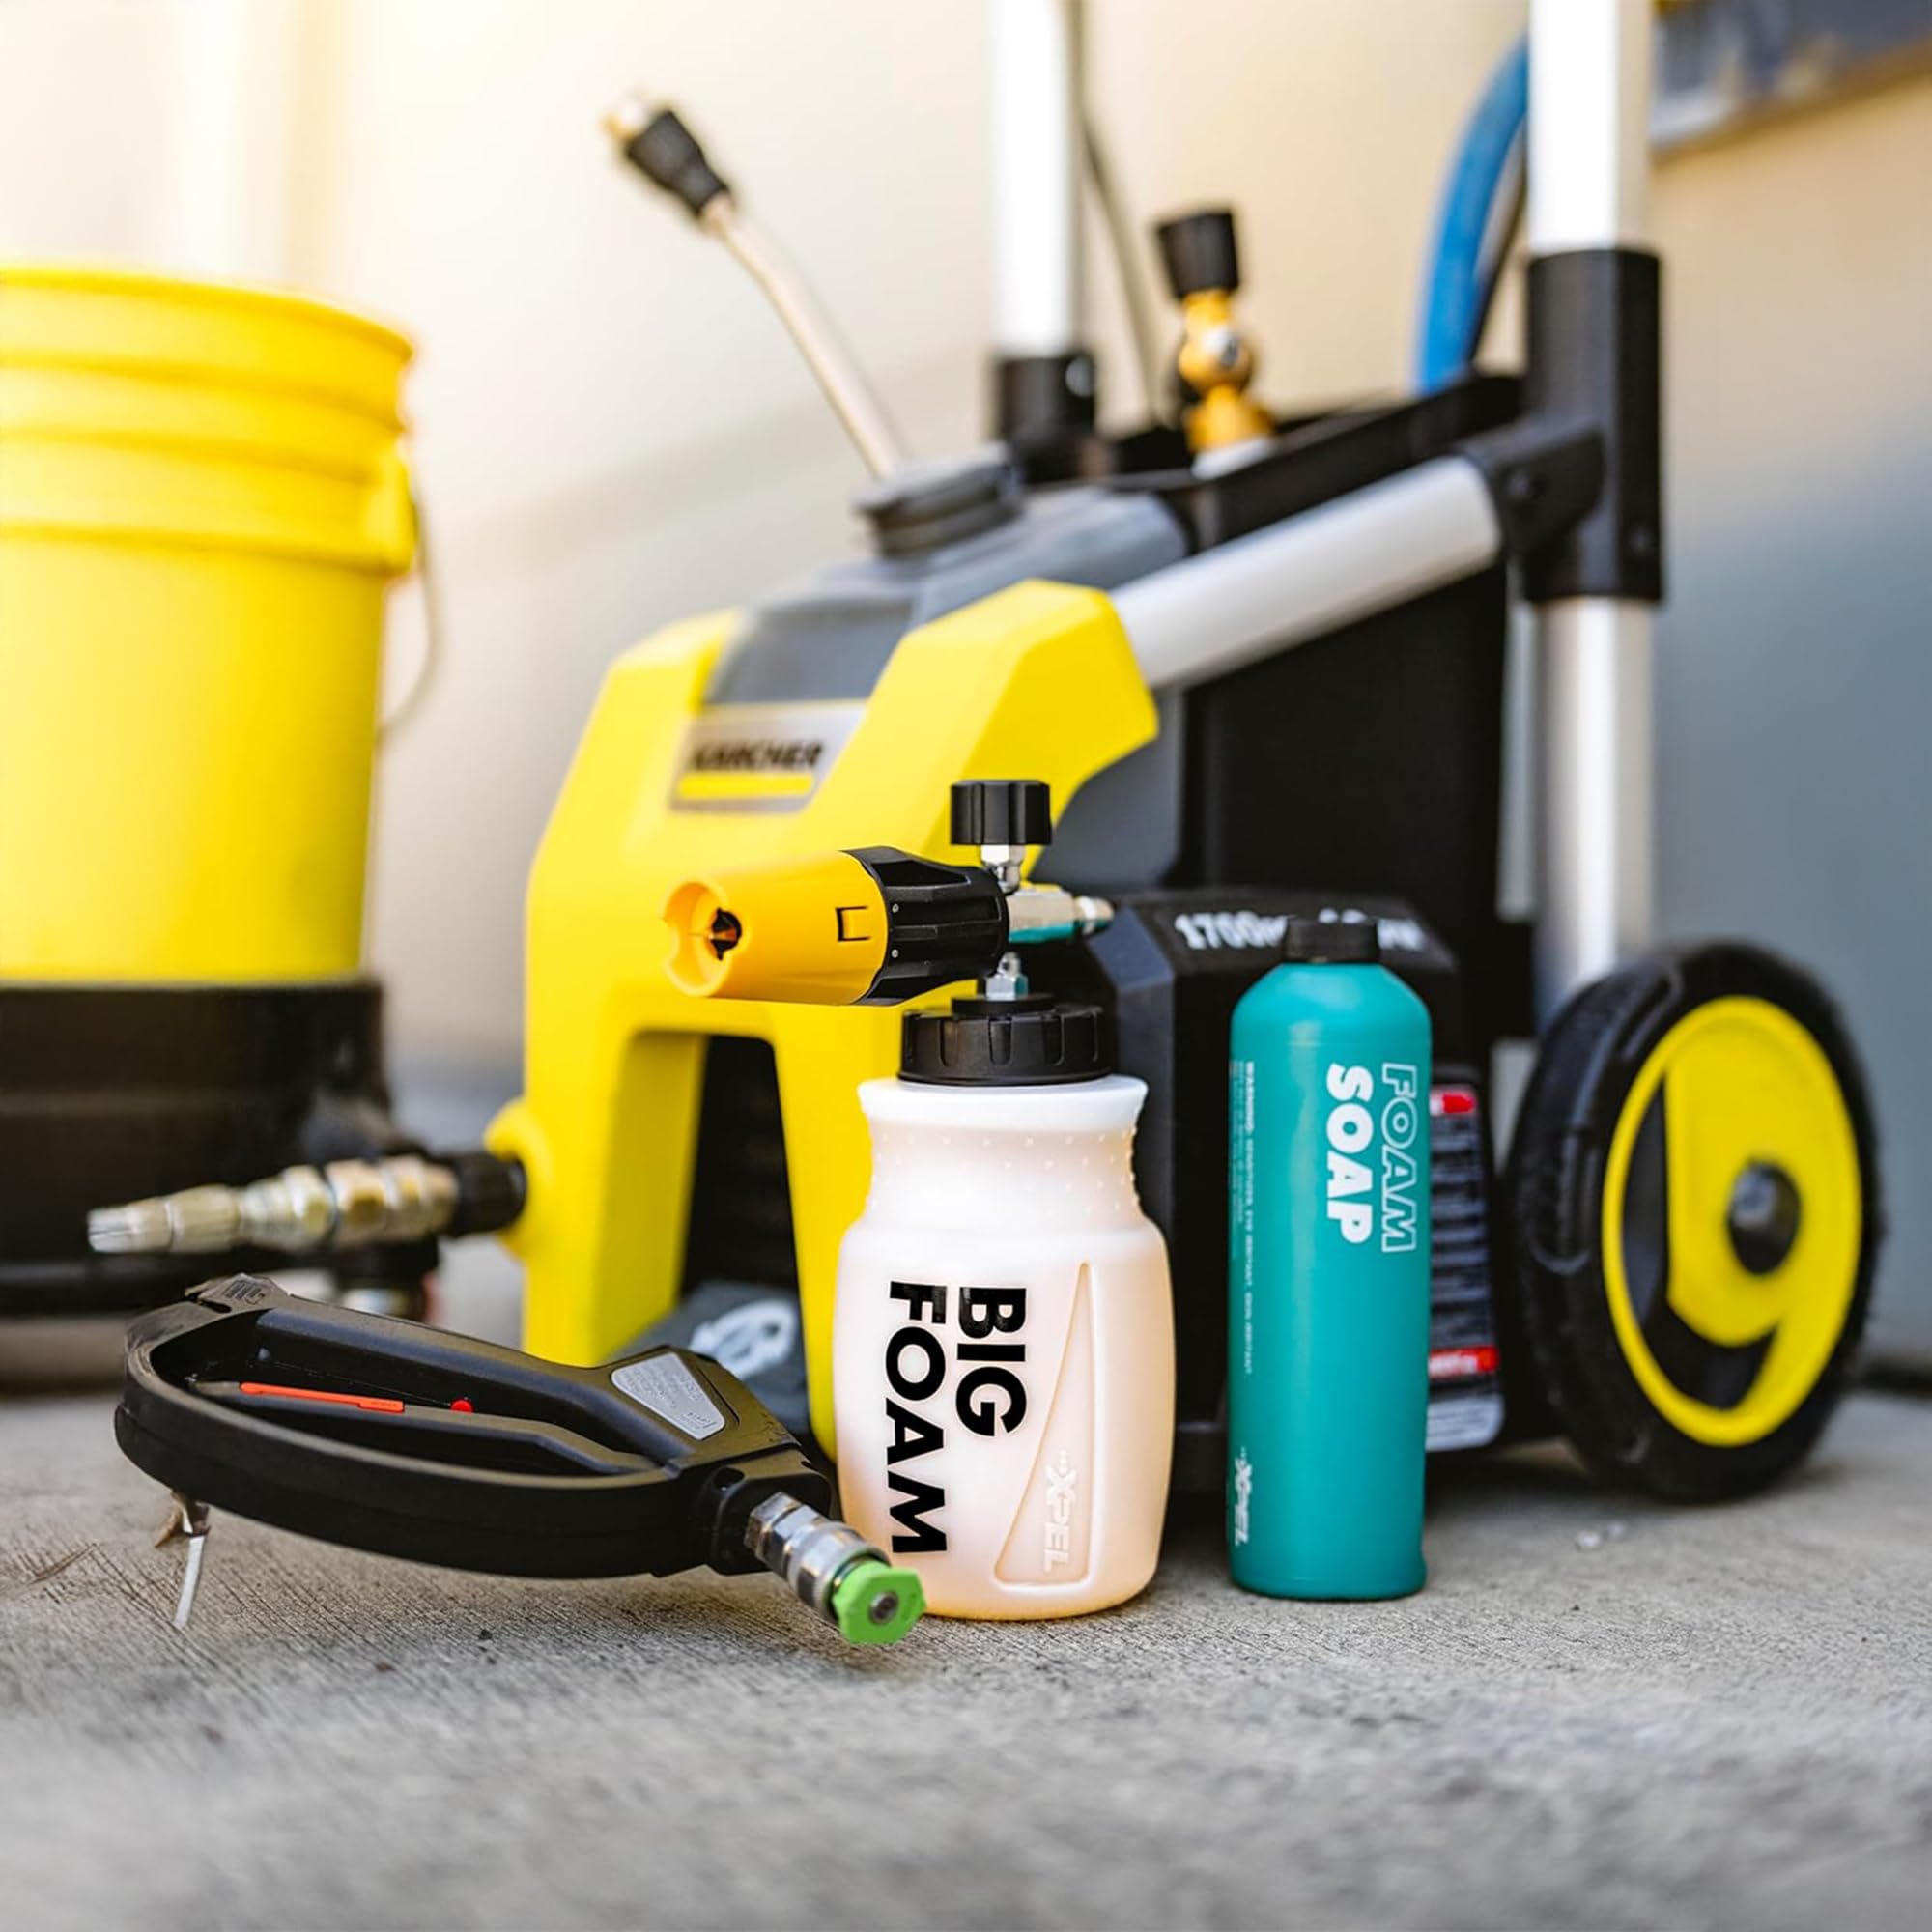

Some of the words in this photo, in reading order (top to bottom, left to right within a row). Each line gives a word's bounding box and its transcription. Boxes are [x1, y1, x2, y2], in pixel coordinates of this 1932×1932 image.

[1326, 1062, 1374, 1244] SOAP
[1381, 1062, 1418, 1253] FOAM
[885, 1280, 948, 1553] FOAM
[955, 1286, 1028, 1437] BIG
[1043, 1449, 1075, 1573] XPEL
